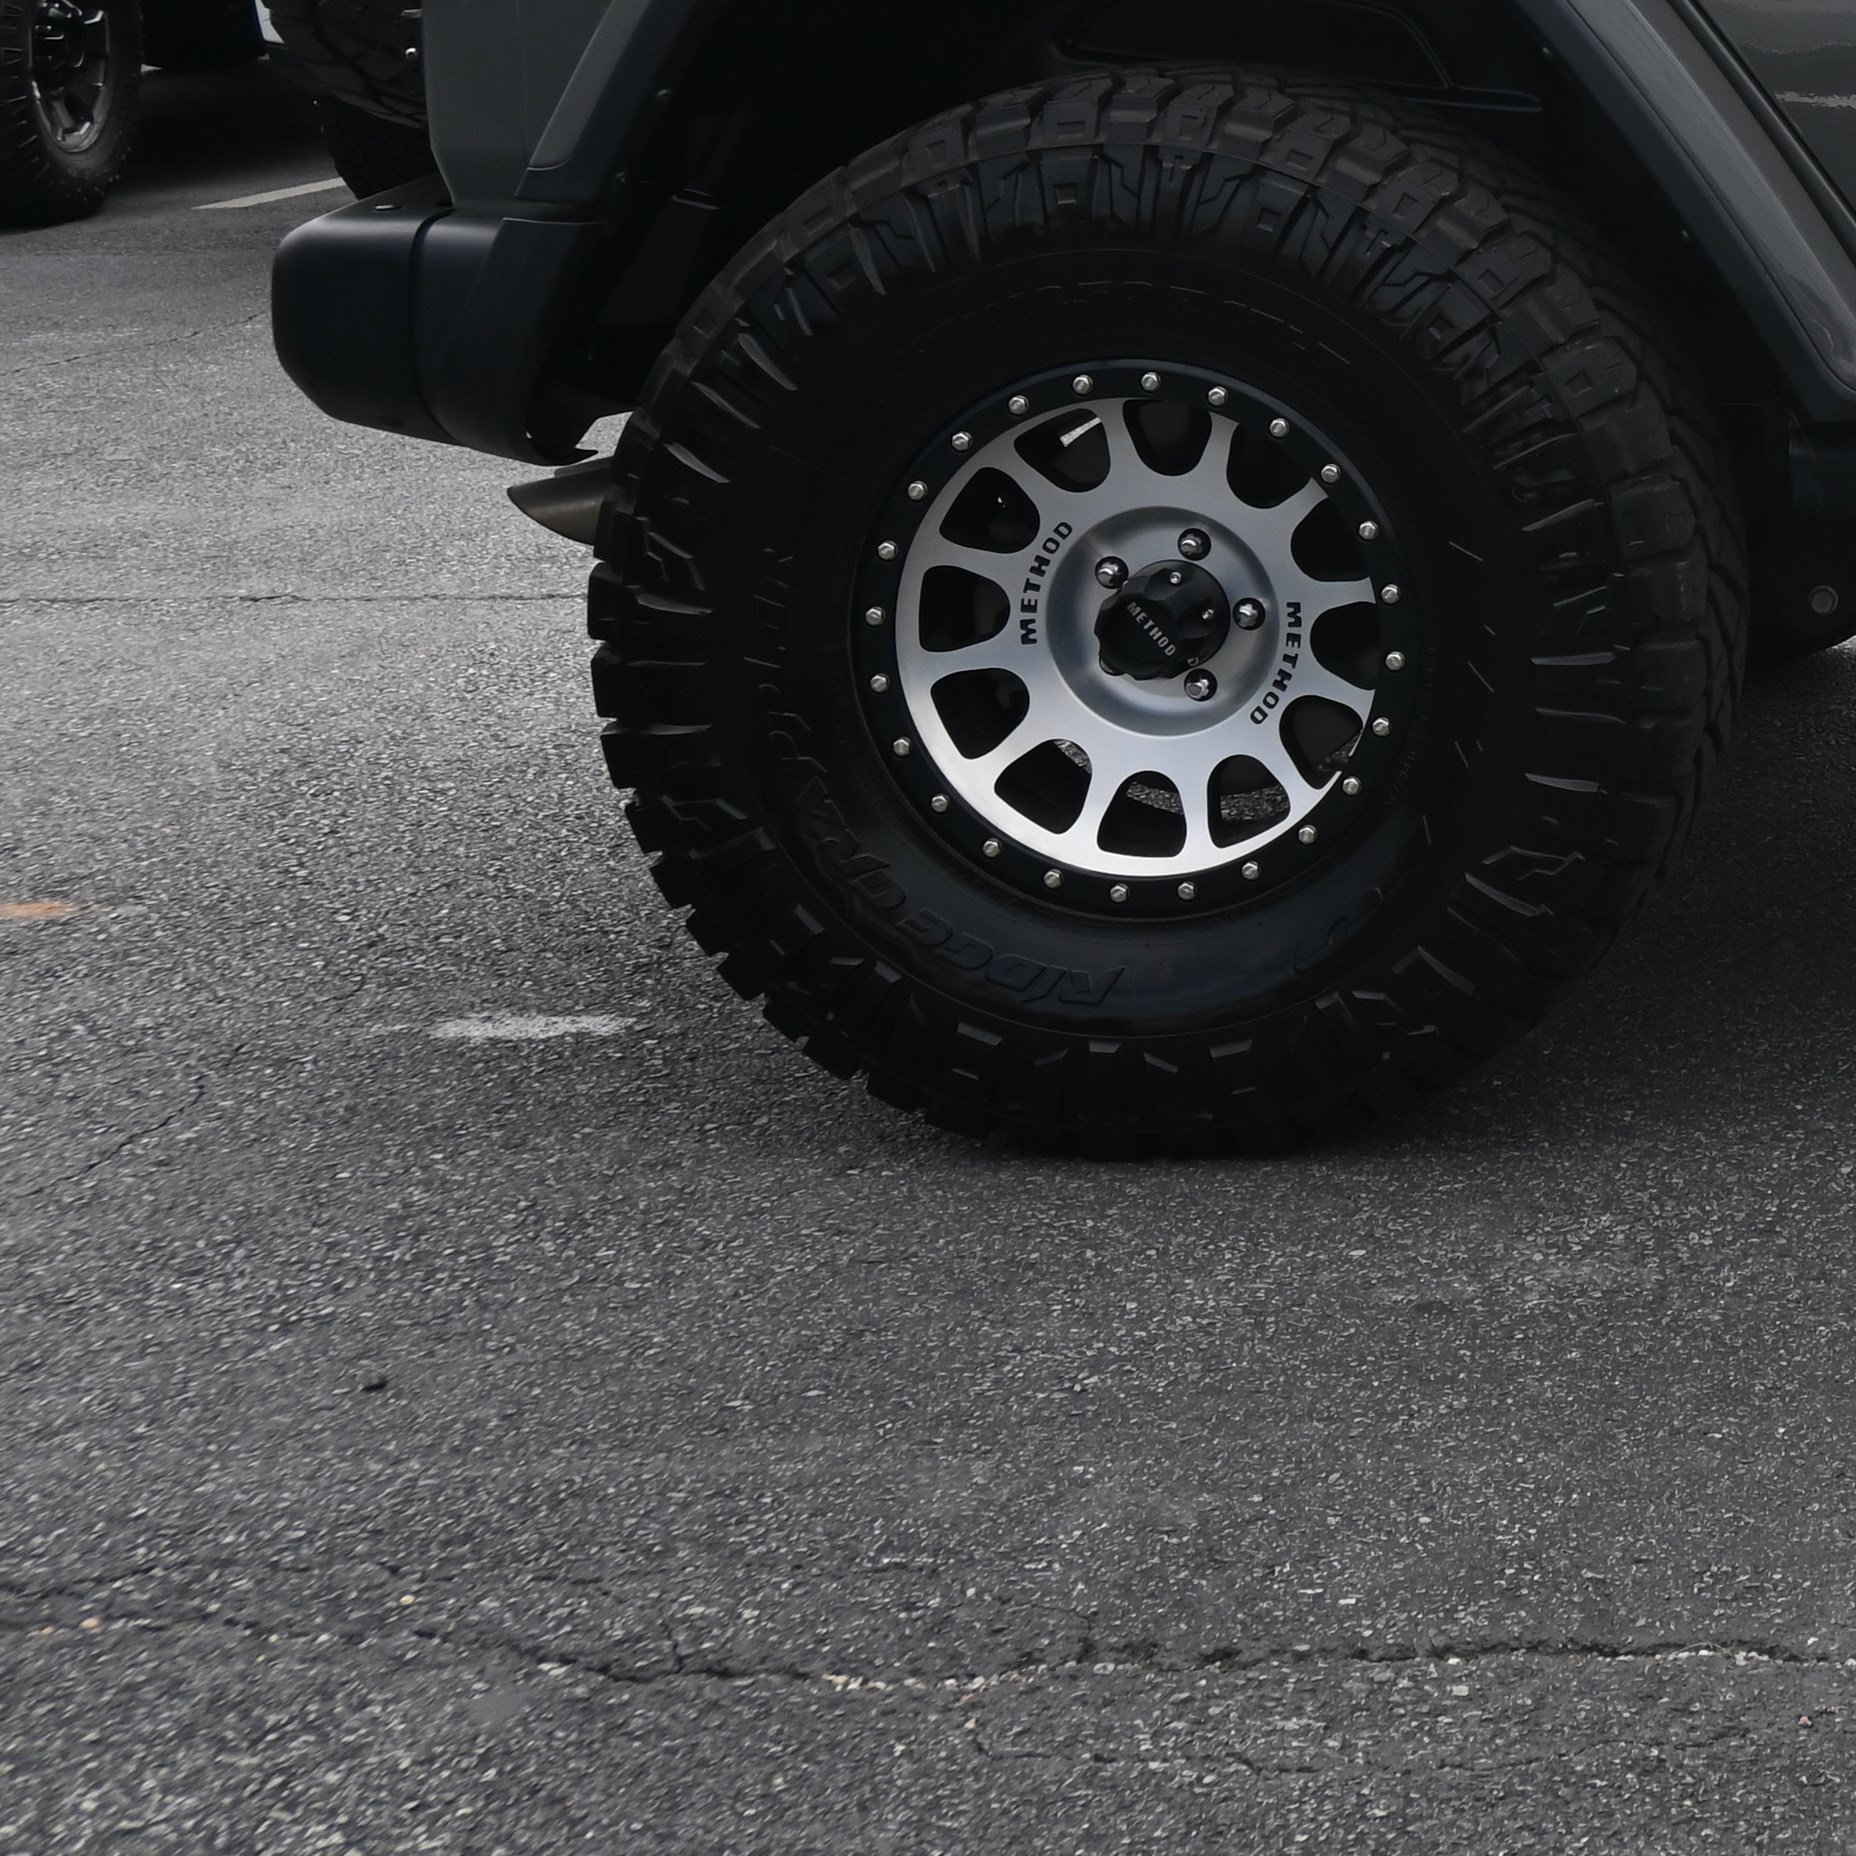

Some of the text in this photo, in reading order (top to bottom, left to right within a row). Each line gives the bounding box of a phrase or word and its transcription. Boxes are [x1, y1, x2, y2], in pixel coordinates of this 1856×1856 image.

[1020, 522, 1073, 646] METHOD
[1126, 601, 1176, 656] METHOD
[1249, 601, 1302, 727] METHOD
